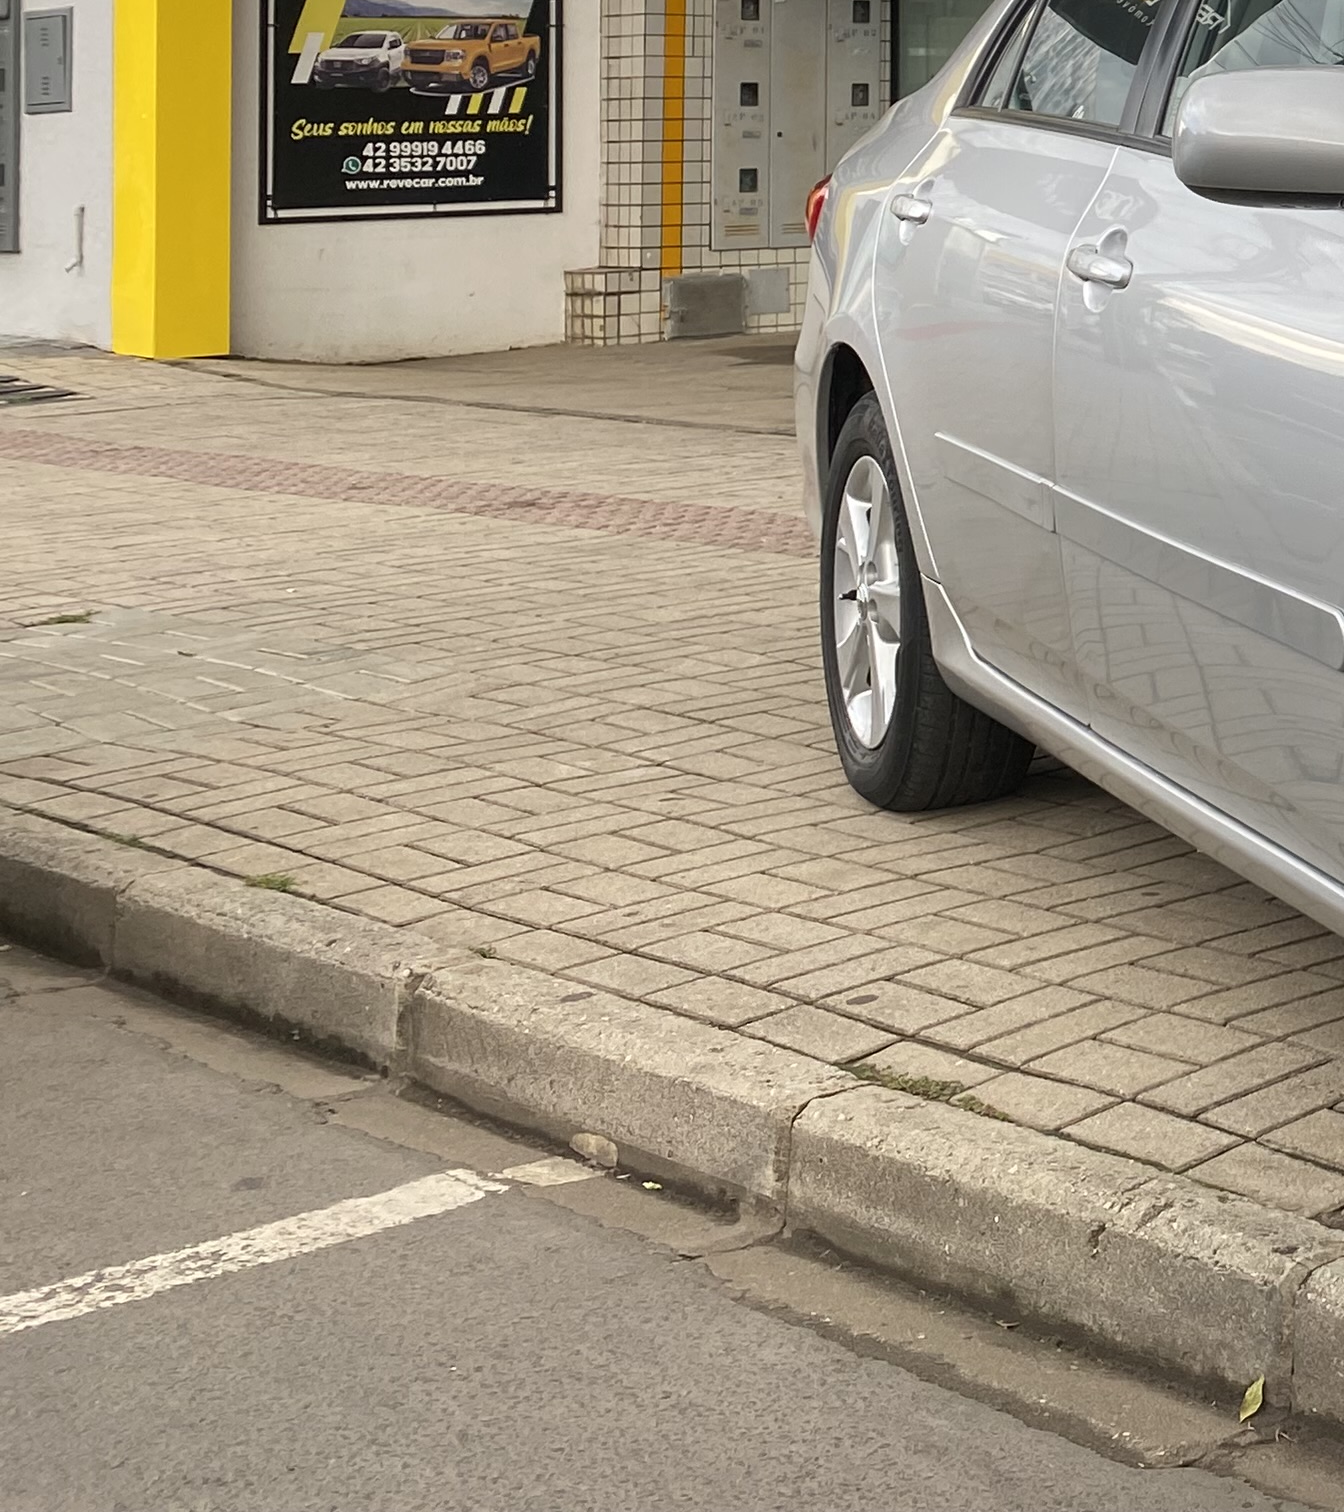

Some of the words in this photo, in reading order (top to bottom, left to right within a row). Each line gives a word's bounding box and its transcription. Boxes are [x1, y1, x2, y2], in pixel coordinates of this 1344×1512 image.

[291, 118, 334, 140] Seus
[338, 117, 395, 136] sonhos
[401, 121, 424, 135] em
[428, 118, 482, 135] nossas
[486, 115, 534, 135] mãos!
[363, 143, 386, 157] 42
[388, 141, 439, 156] 99919
[441, 140, 486, 155] 4466
[362, 158, 386, 173] 42
[388, 157, 434, 172] 3532
[435, 156, 477, 170] 7007
[345, 174, 484, 190] www.revecar.com.br
